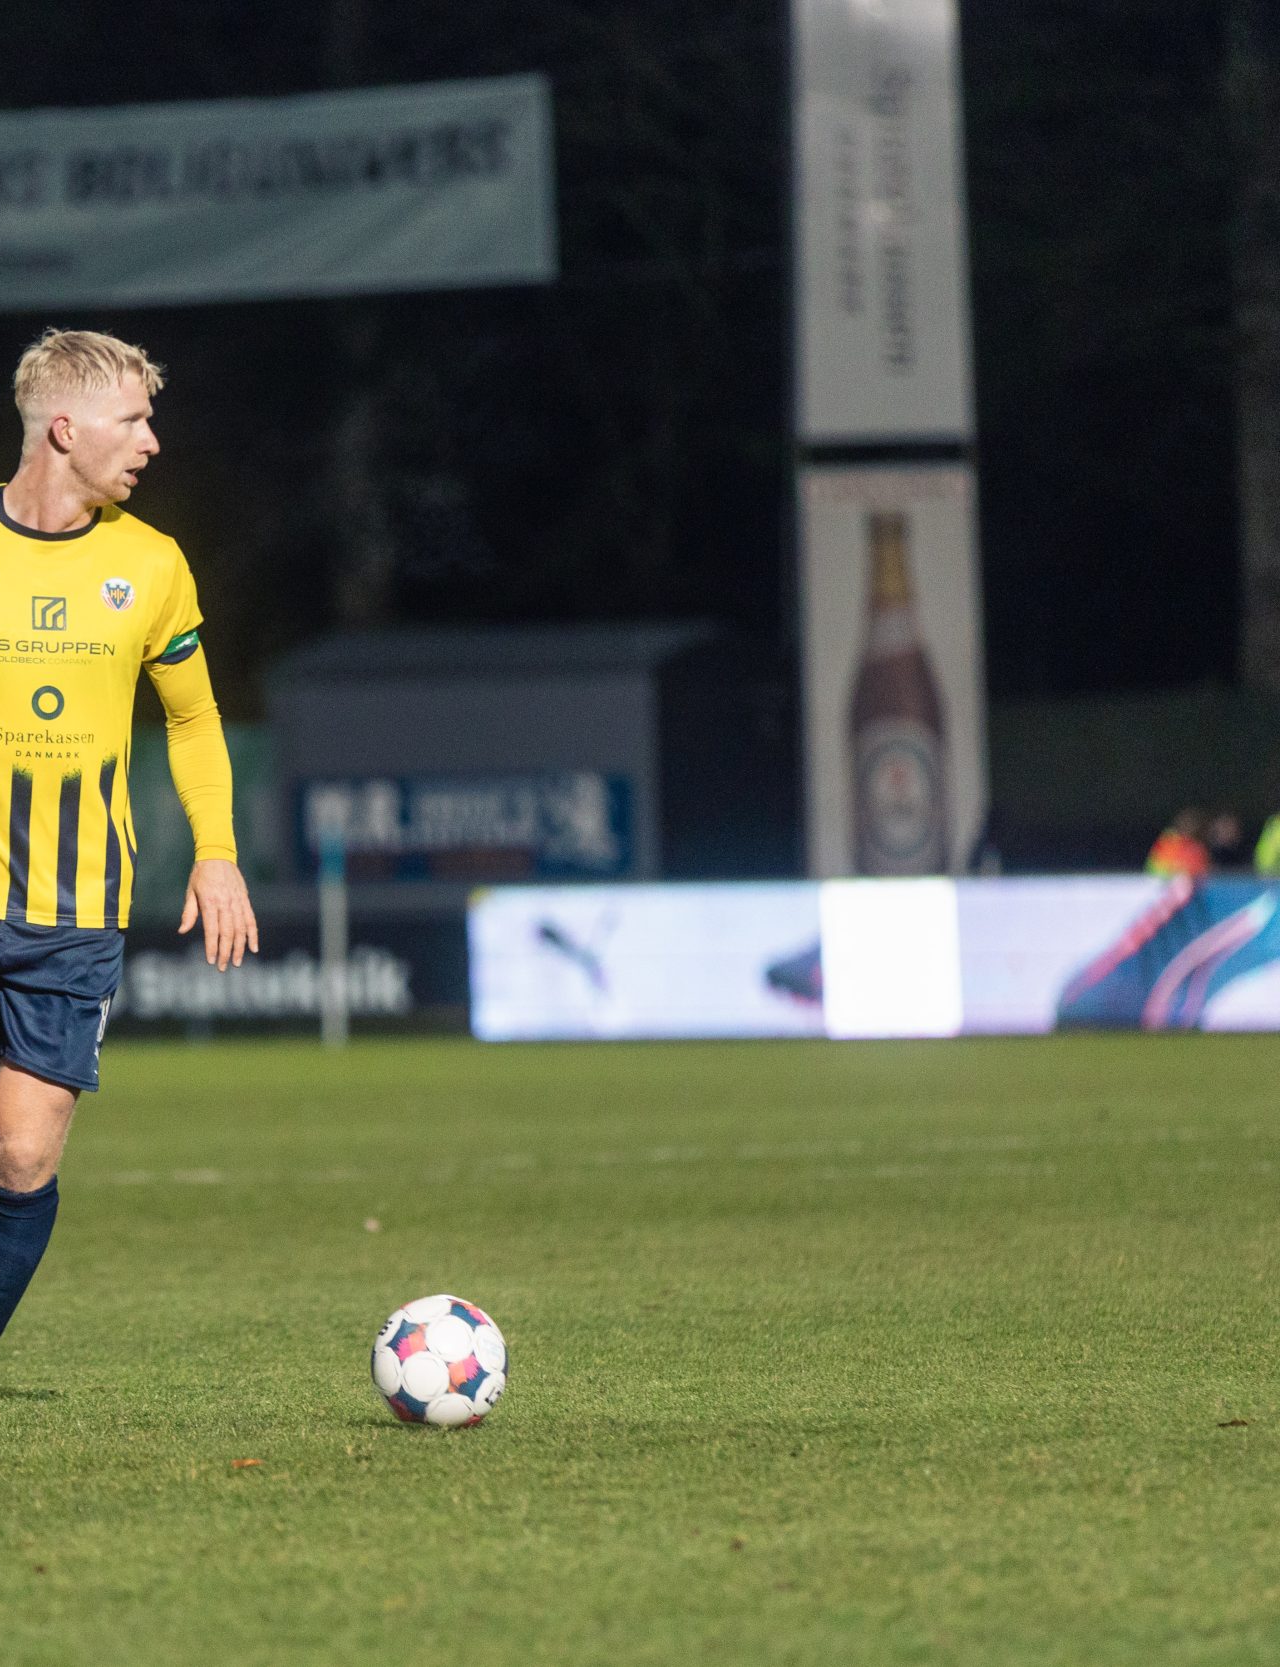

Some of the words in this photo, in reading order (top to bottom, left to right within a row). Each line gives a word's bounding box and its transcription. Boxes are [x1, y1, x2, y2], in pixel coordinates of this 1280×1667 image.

[15, 640, 115, 656] GRUPPEN
[48, 657, 93, 665] COMPANY
[16, 750, 80, 758] DANMARK
